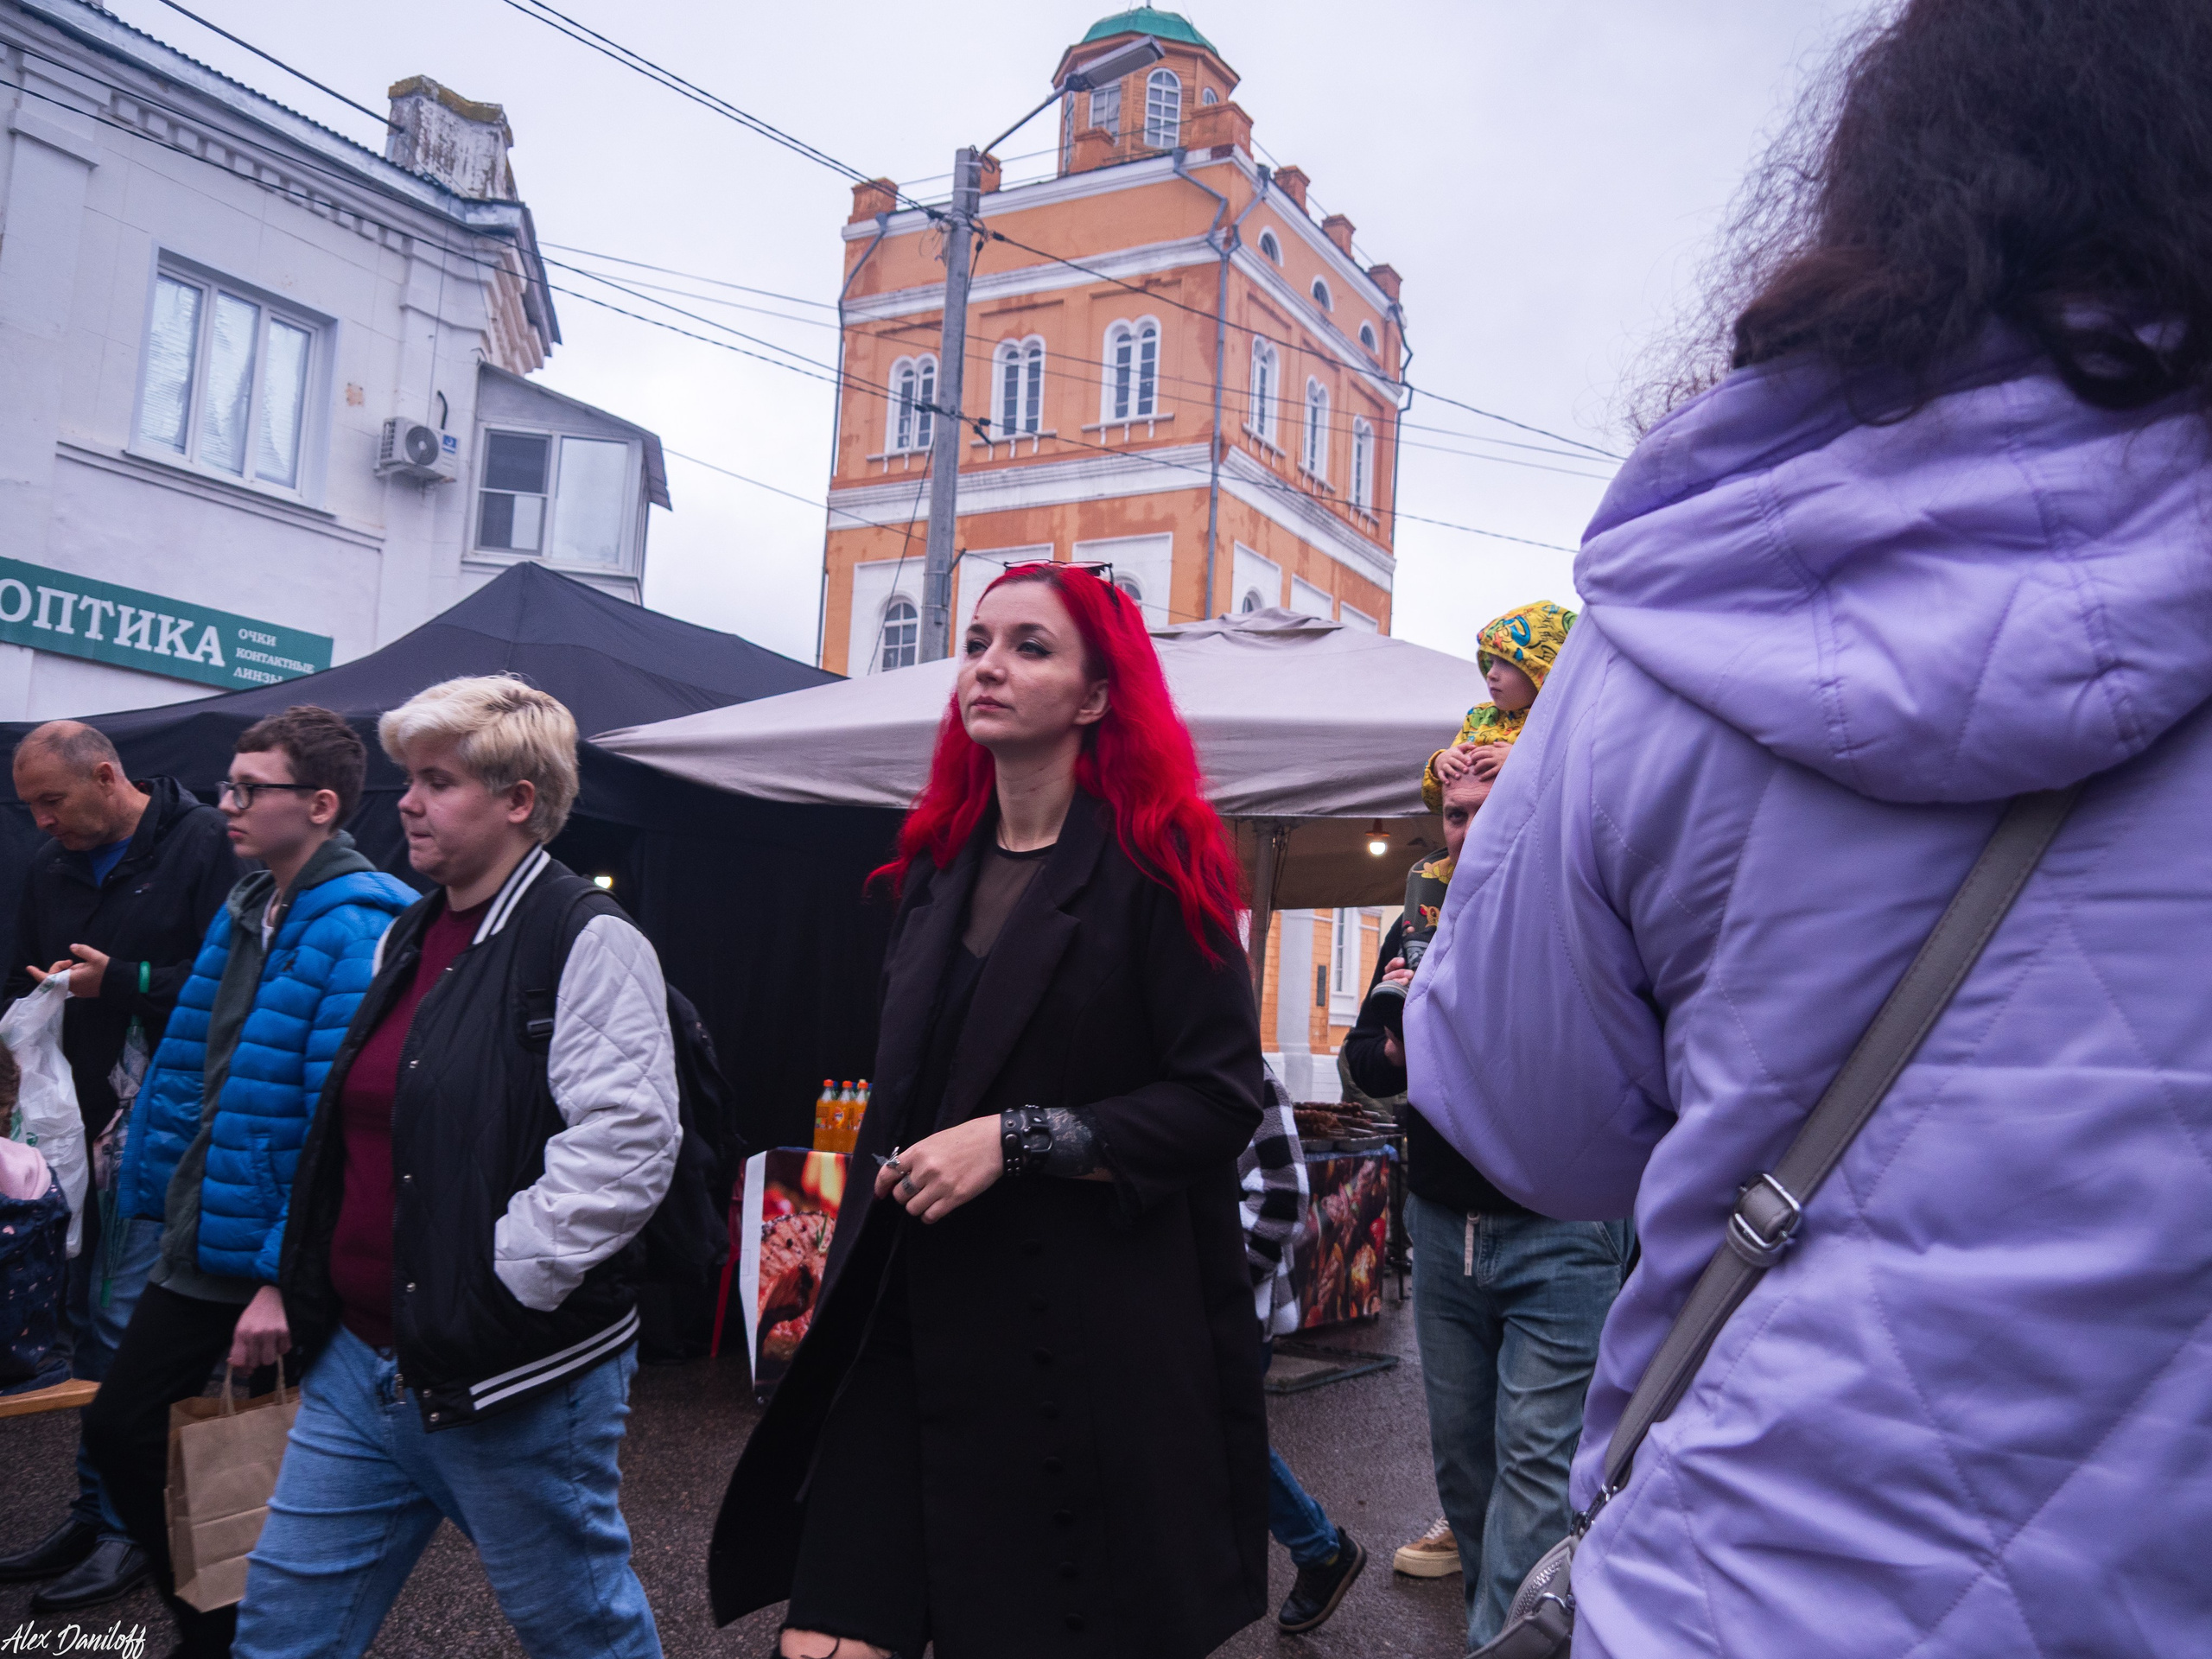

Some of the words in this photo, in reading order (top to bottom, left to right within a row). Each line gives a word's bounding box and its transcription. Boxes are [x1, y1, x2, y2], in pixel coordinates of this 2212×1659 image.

[0, 578, 226, 667] ОПТИКА
[238, 628, 276, 647] ОЧКИ
[236, 647, 315, 674] КОНТАКТНЫЕ
